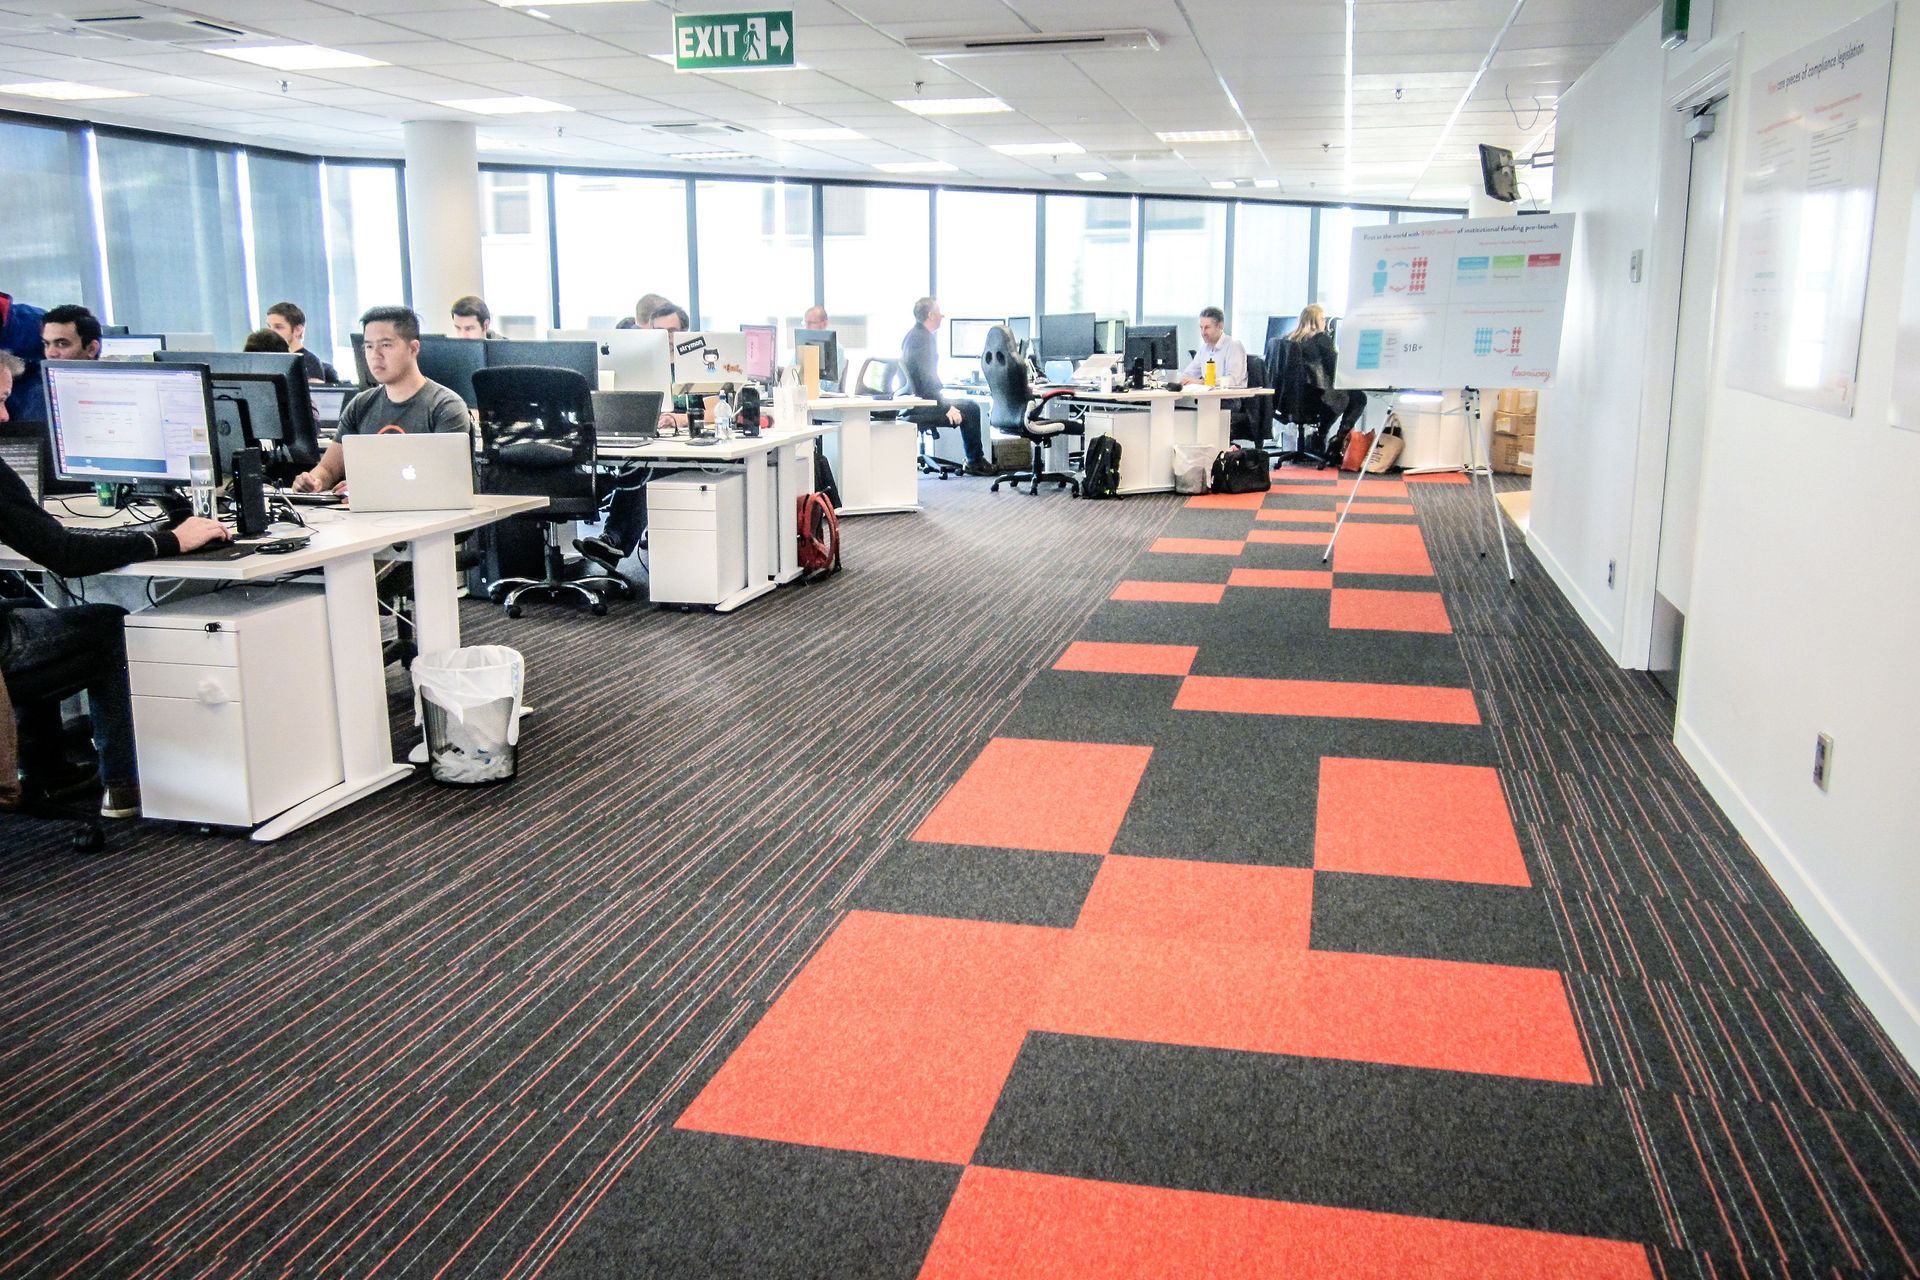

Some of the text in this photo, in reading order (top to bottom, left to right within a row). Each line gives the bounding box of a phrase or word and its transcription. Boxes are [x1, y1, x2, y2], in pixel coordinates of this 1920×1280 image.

[679, 24, 740, 58] EXIT
[1382, 232, 1392, 240] the
[1392, 231, 1408, 239] world
[1464, 225, 1500, 233] institutional
[1500, 224, 1524, 232] funding
[678, 339, 704, 353] strymon
[1402, 343, 1424, 353] $1B+
